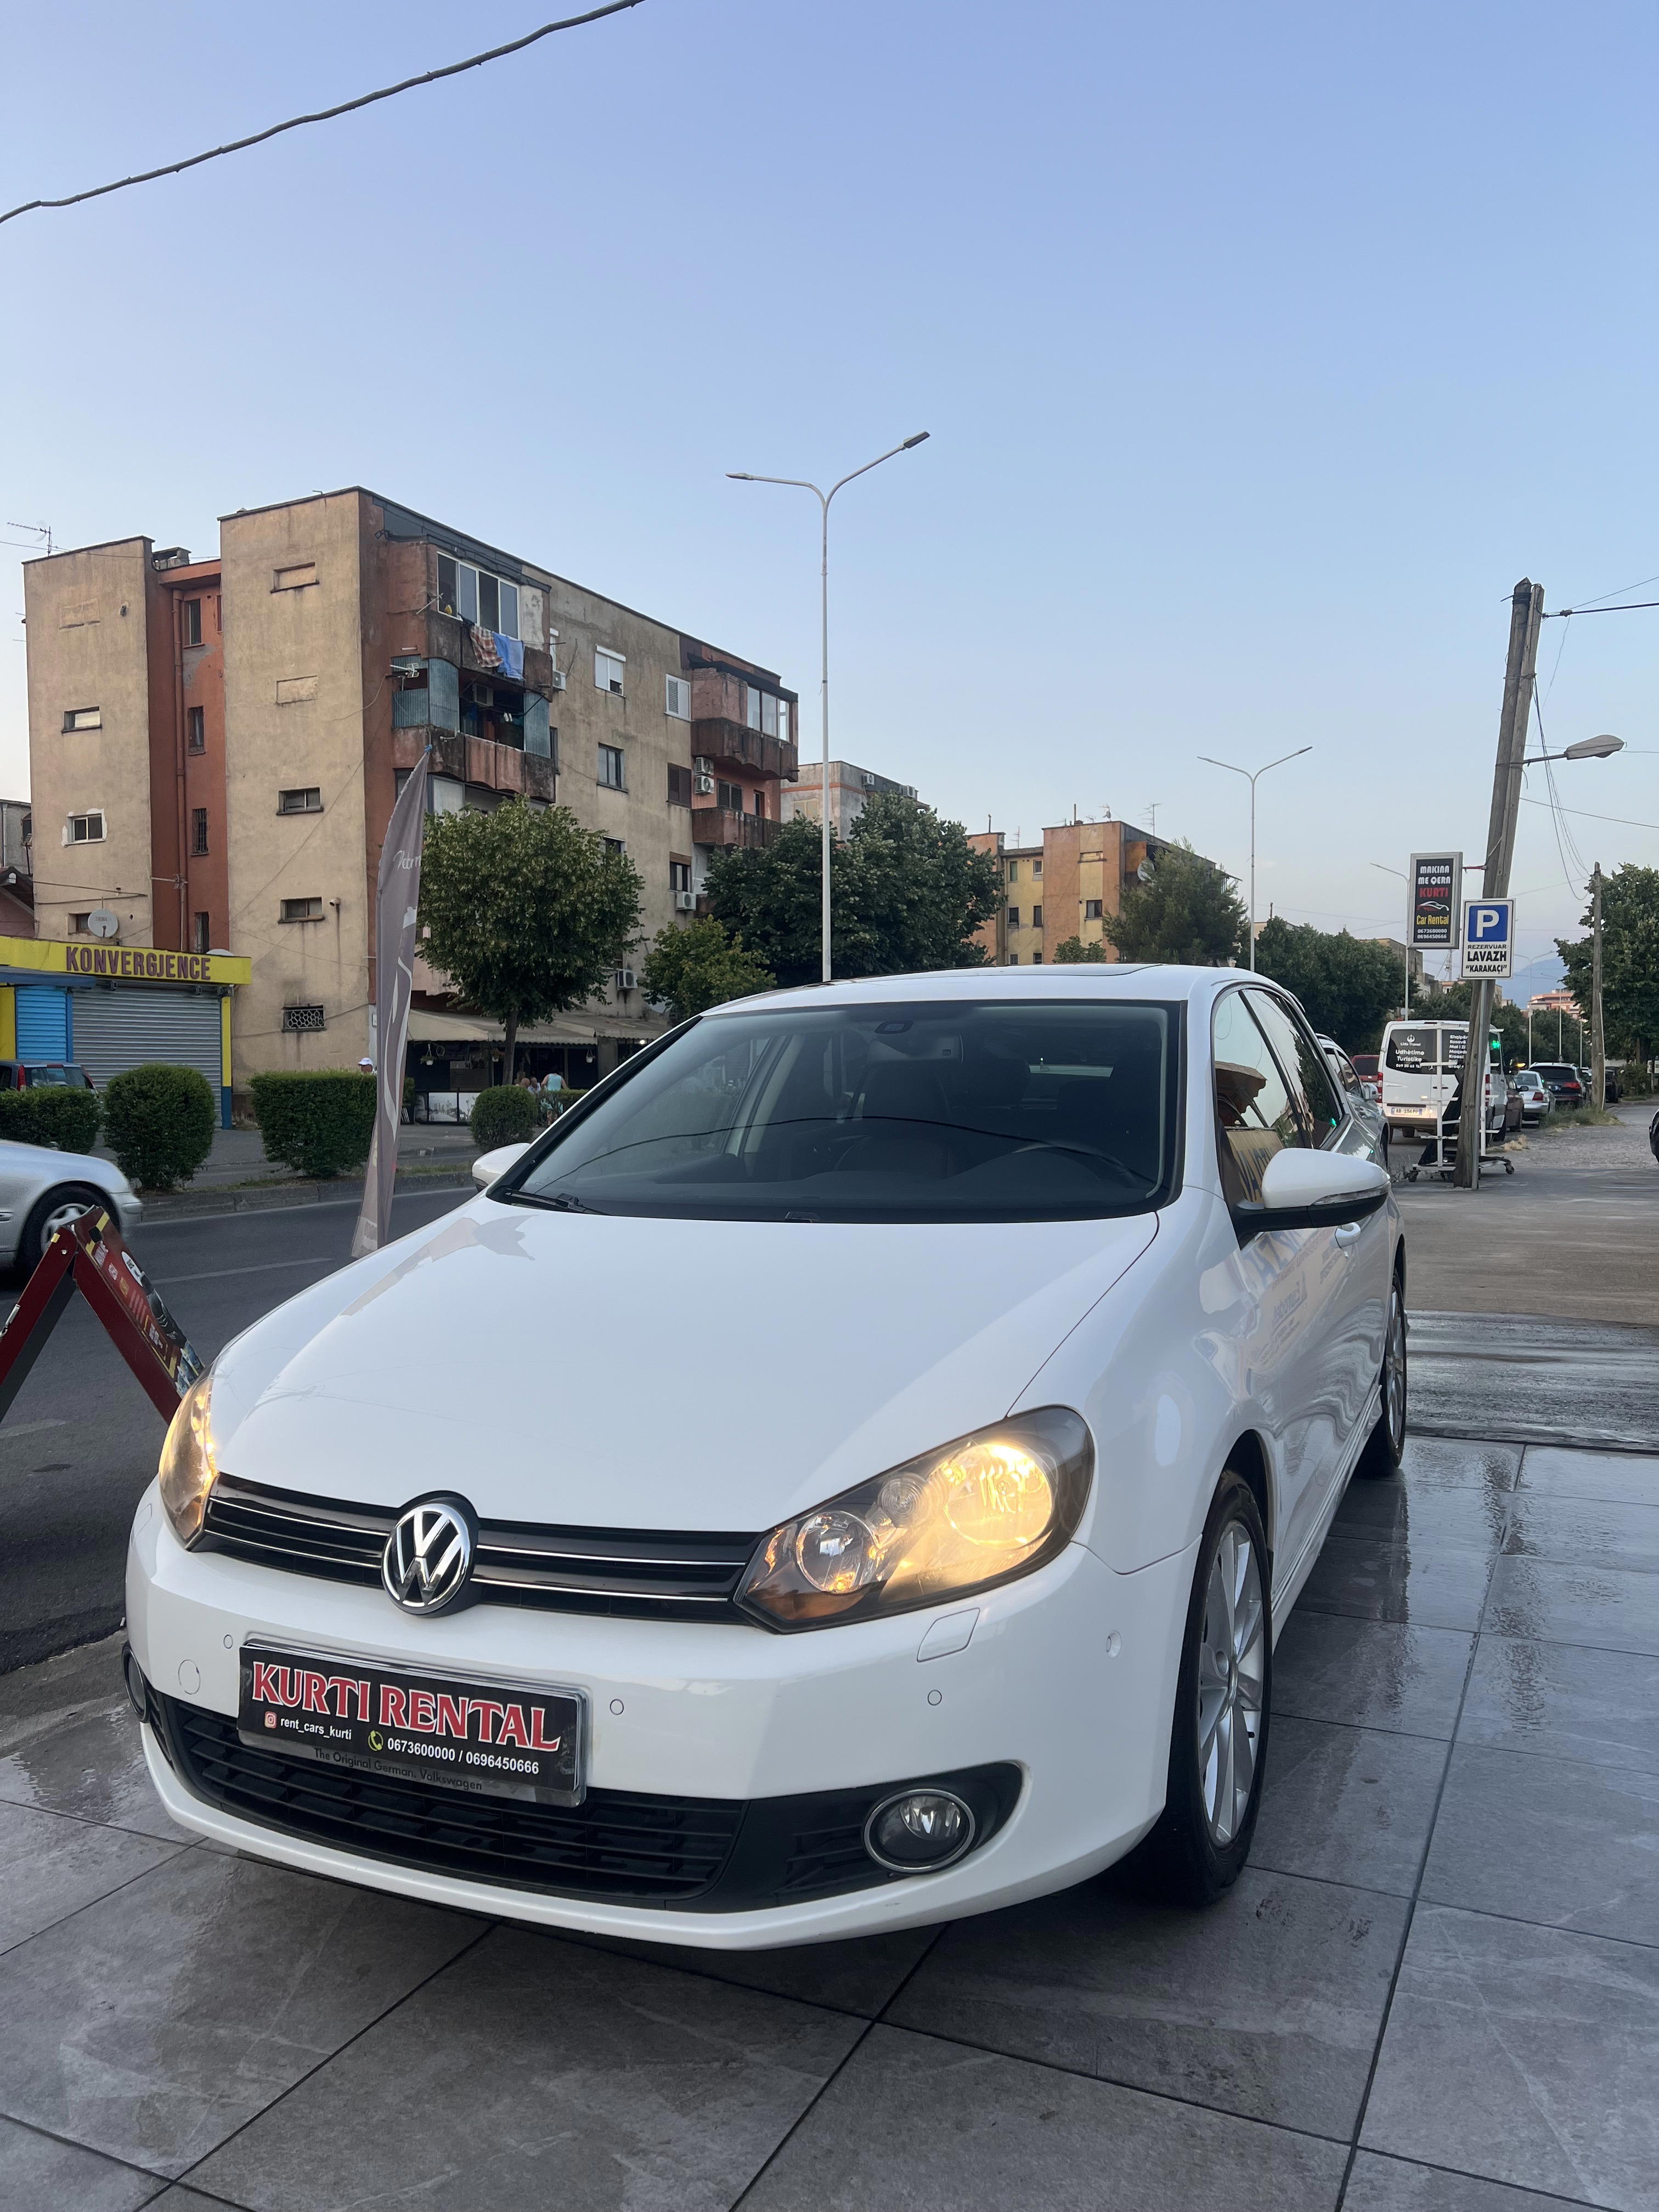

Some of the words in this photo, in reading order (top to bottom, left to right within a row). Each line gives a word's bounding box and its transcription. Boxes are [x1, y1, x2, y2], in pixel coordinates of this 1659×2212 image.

[1420, 865, 1449, 874] MAKINA
[1430, 876, 1451, 885] QERA
[1419, 887, 1449, 898] KURTI
[1417, 915, 1427, 925] Car
[1427, 915, 1449, 925] Rental
[1476, 909, 1499, 938] P
[66, 946, 211, 980] KONVERGJENCE
[1467, 951, 1506, 962] LAVAZH
[252, 1661, 371, 1723] KURTI
[379, 1684, 561, 1752] RENTAL
[280, 1718, 352, 1740] rent_cars_kurti
[387, 1737, 455, 1761] 0673600000
[458, 1750, 463, 1762] /
[466, 1751, 539, 1774] 0696450666
[314, 1747, 330, 1760] The
[334, 1752, 371, 1768] Original
[420, 1769, 482, 1790] Volkswagen
